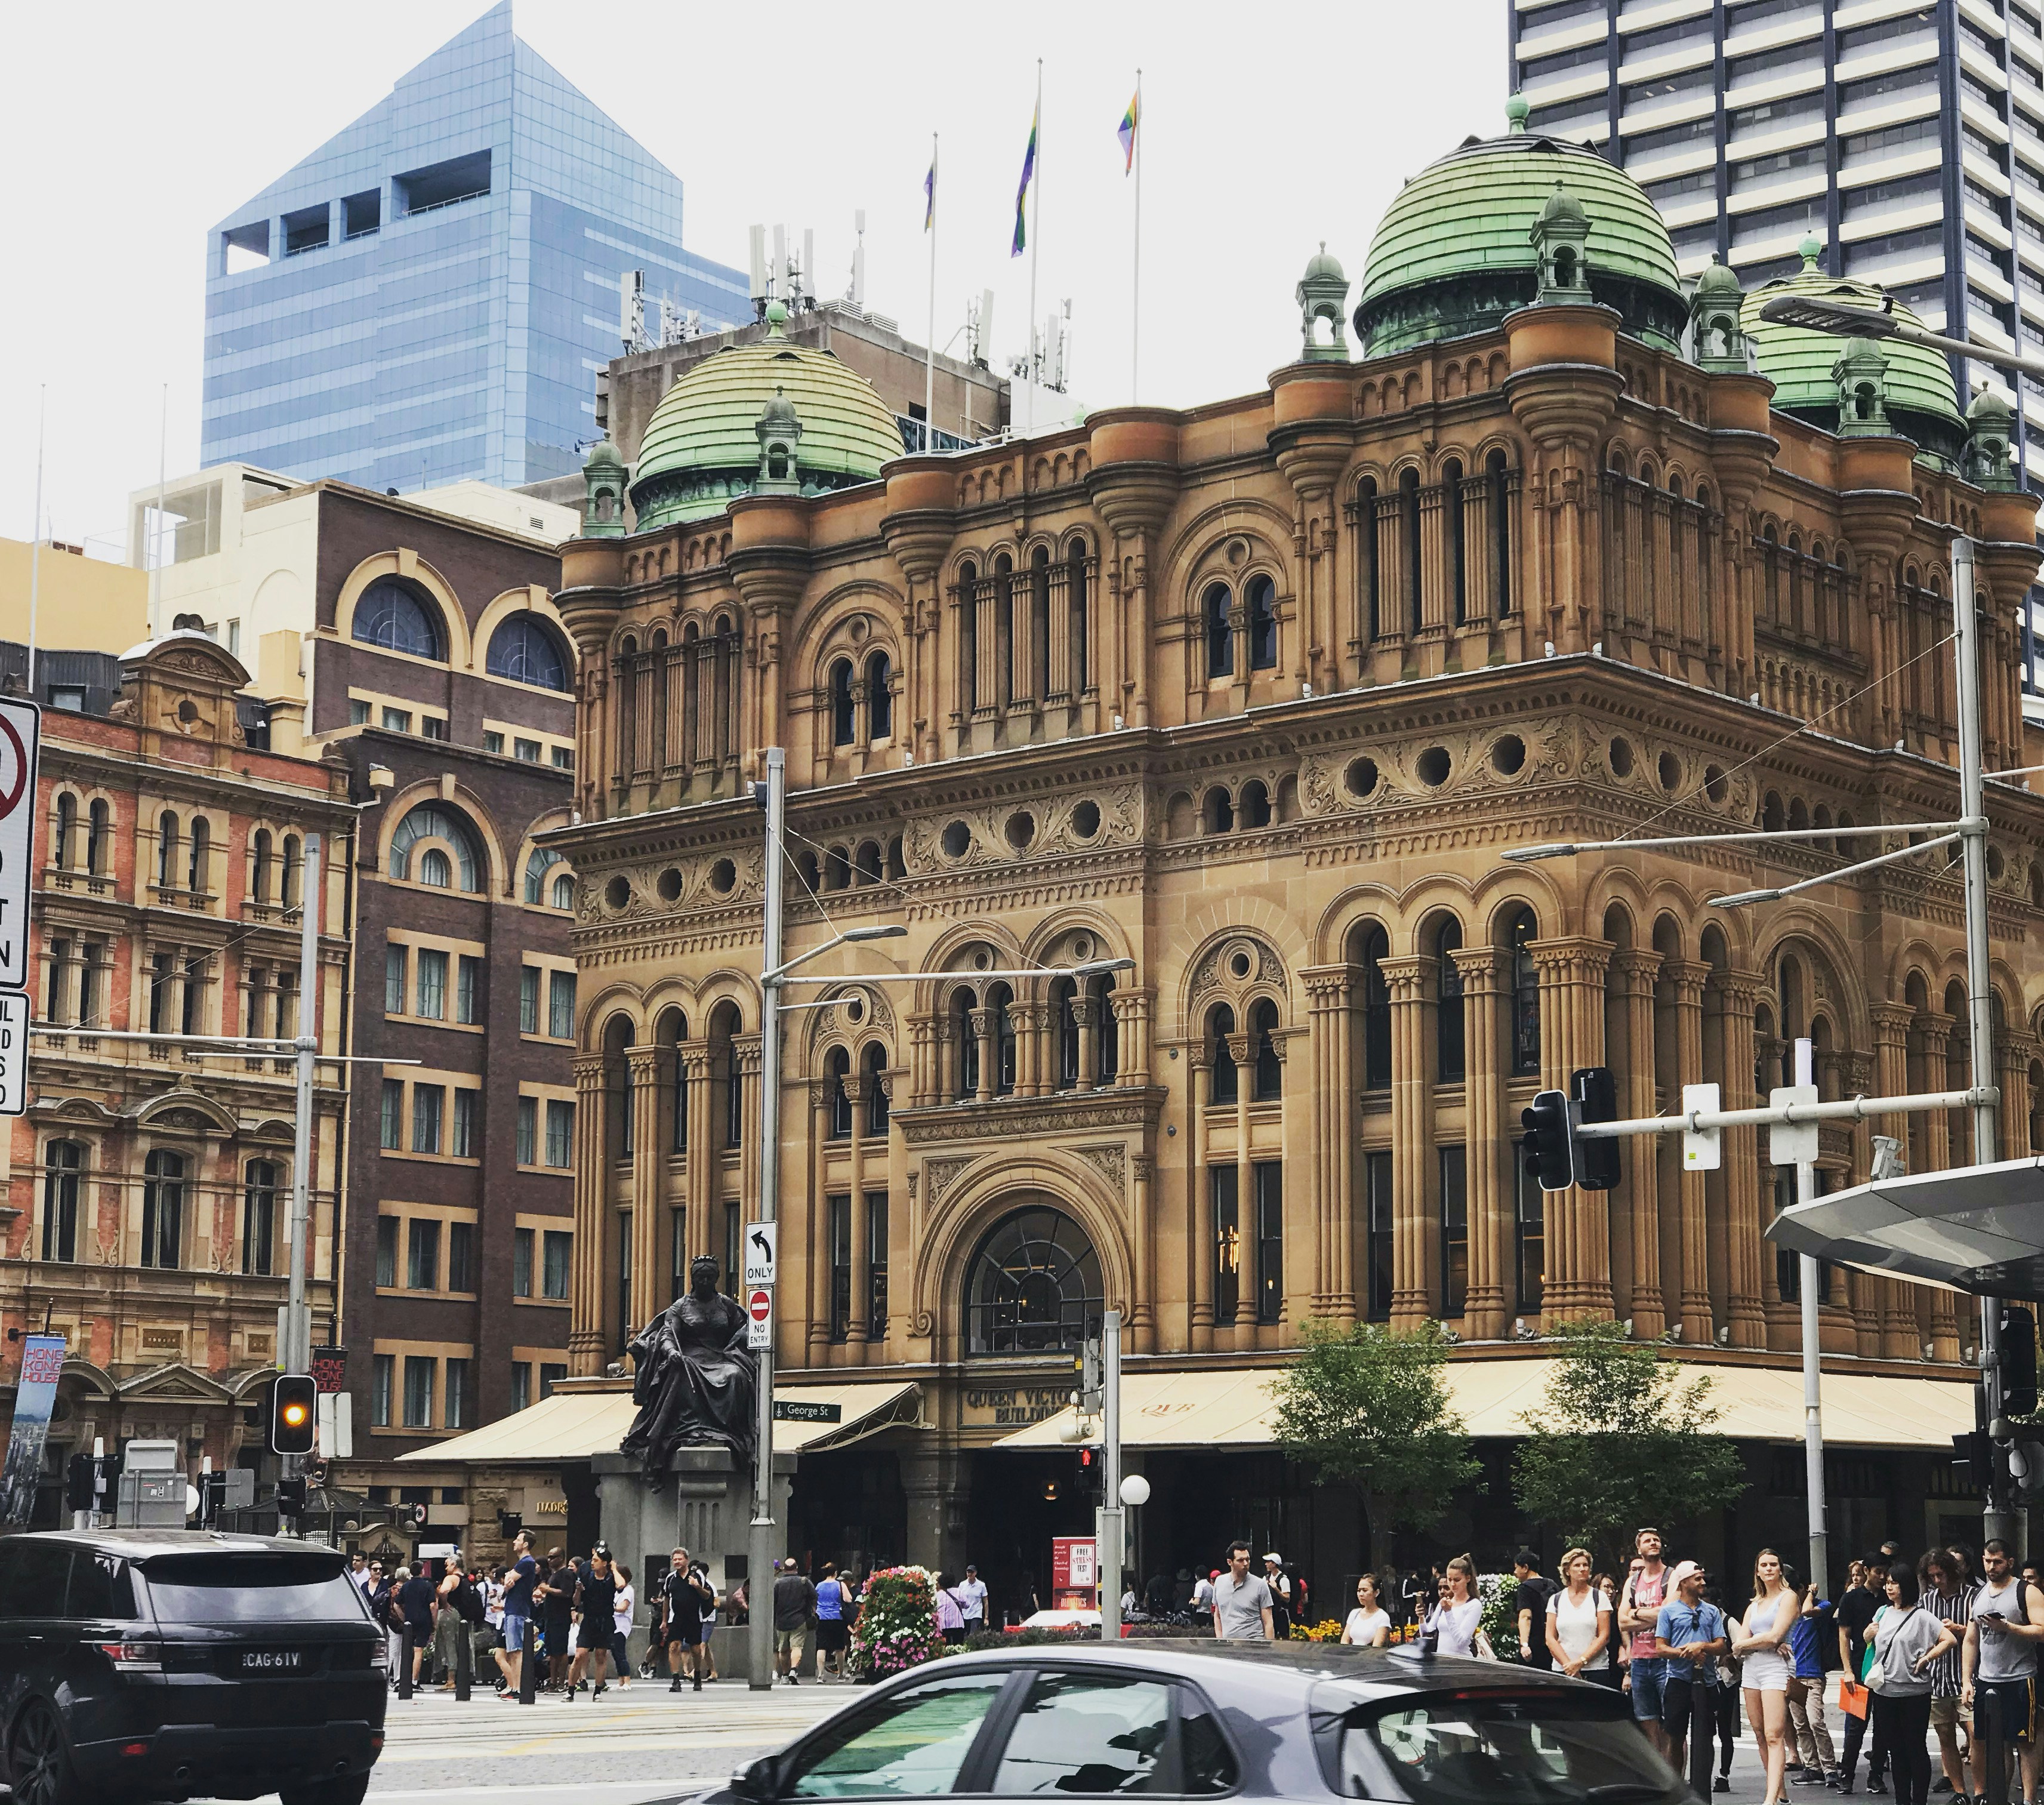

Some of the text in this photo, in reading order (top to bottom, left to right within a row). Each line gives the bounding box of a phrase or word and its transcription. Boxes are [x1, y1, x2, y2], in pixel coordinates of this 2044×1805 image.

[748, 1267, 773, 1279] ONLY
[754, 1325, 765, 1333] NO
[26, 1348, 64, 1360] HONG
[24, 1360, 62, 1372] KONG
[313, 1359, 345, 1370] HONG
[21, 1372, 59, 1383] HOUSE
[312, 1370, 344, 1381] KONG
[316, 1381, 342, 1391] OUSE
[967, 1388, 1072, 1408] QUEEN VICTO
[787, 1404, 828, 1418] George St
